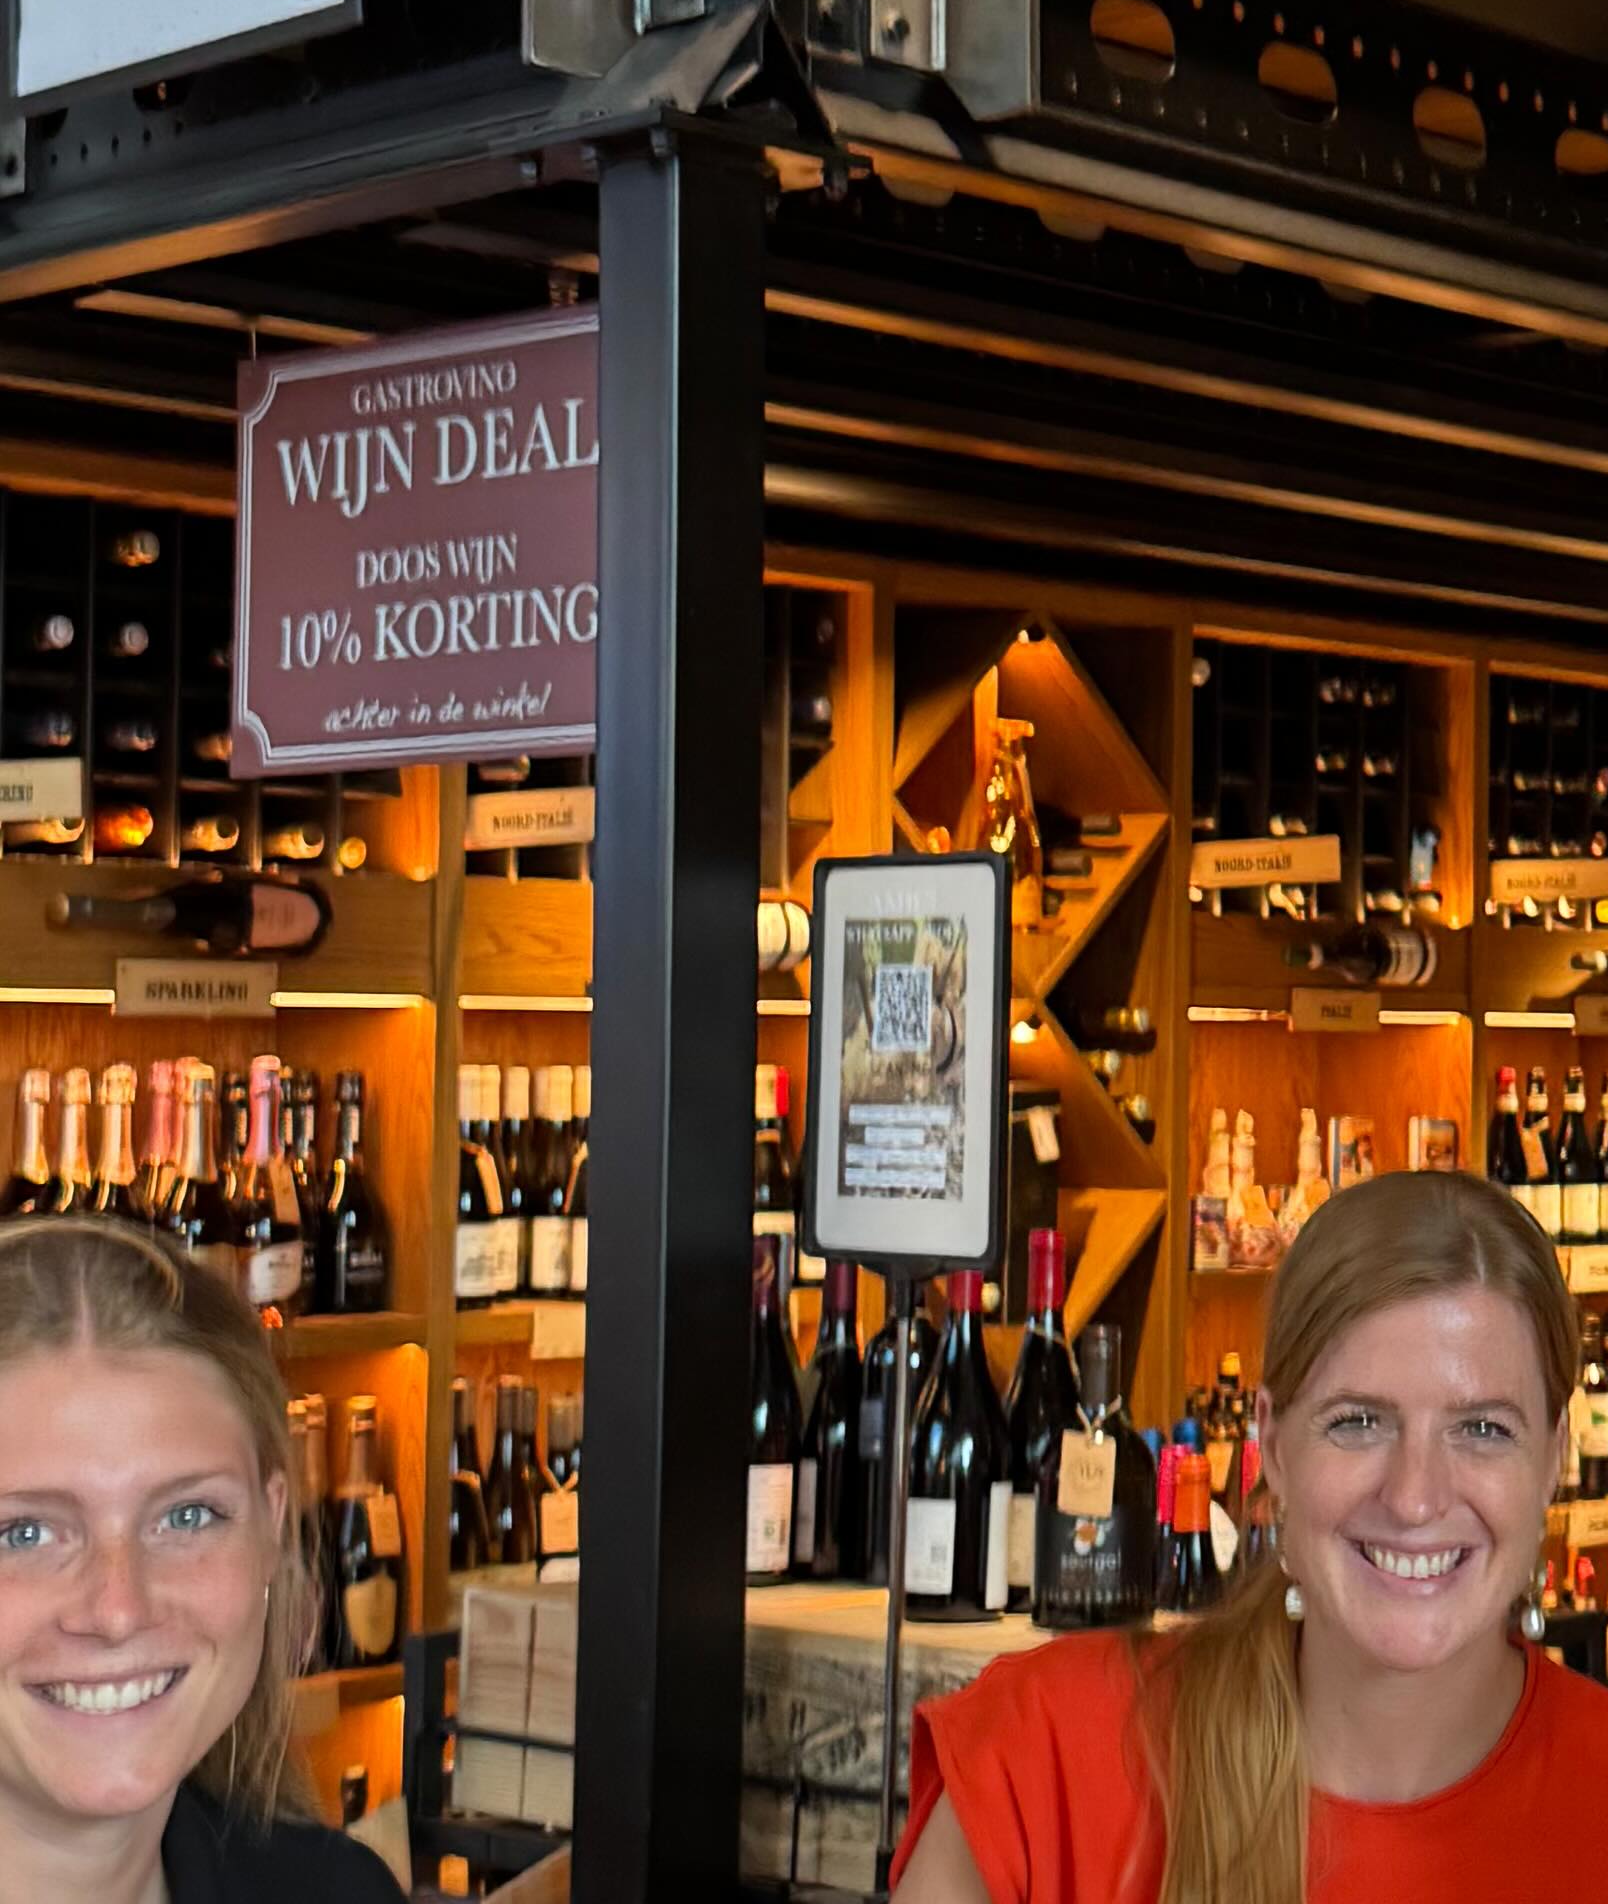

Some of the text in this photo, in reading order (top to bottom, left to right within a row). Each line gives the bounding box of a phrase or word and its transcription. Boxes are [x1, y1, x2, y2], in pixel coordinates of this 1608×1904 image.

[352, 359, 517, 415] GASTROVINO
[277, 397, 600, 518] WIJN DEAL
[356, 529, 518, 589] DOOS WIJN
[278, 581, 600, 671] 10% KORTING
[322, 680, 553, 734] achter in de winkel
